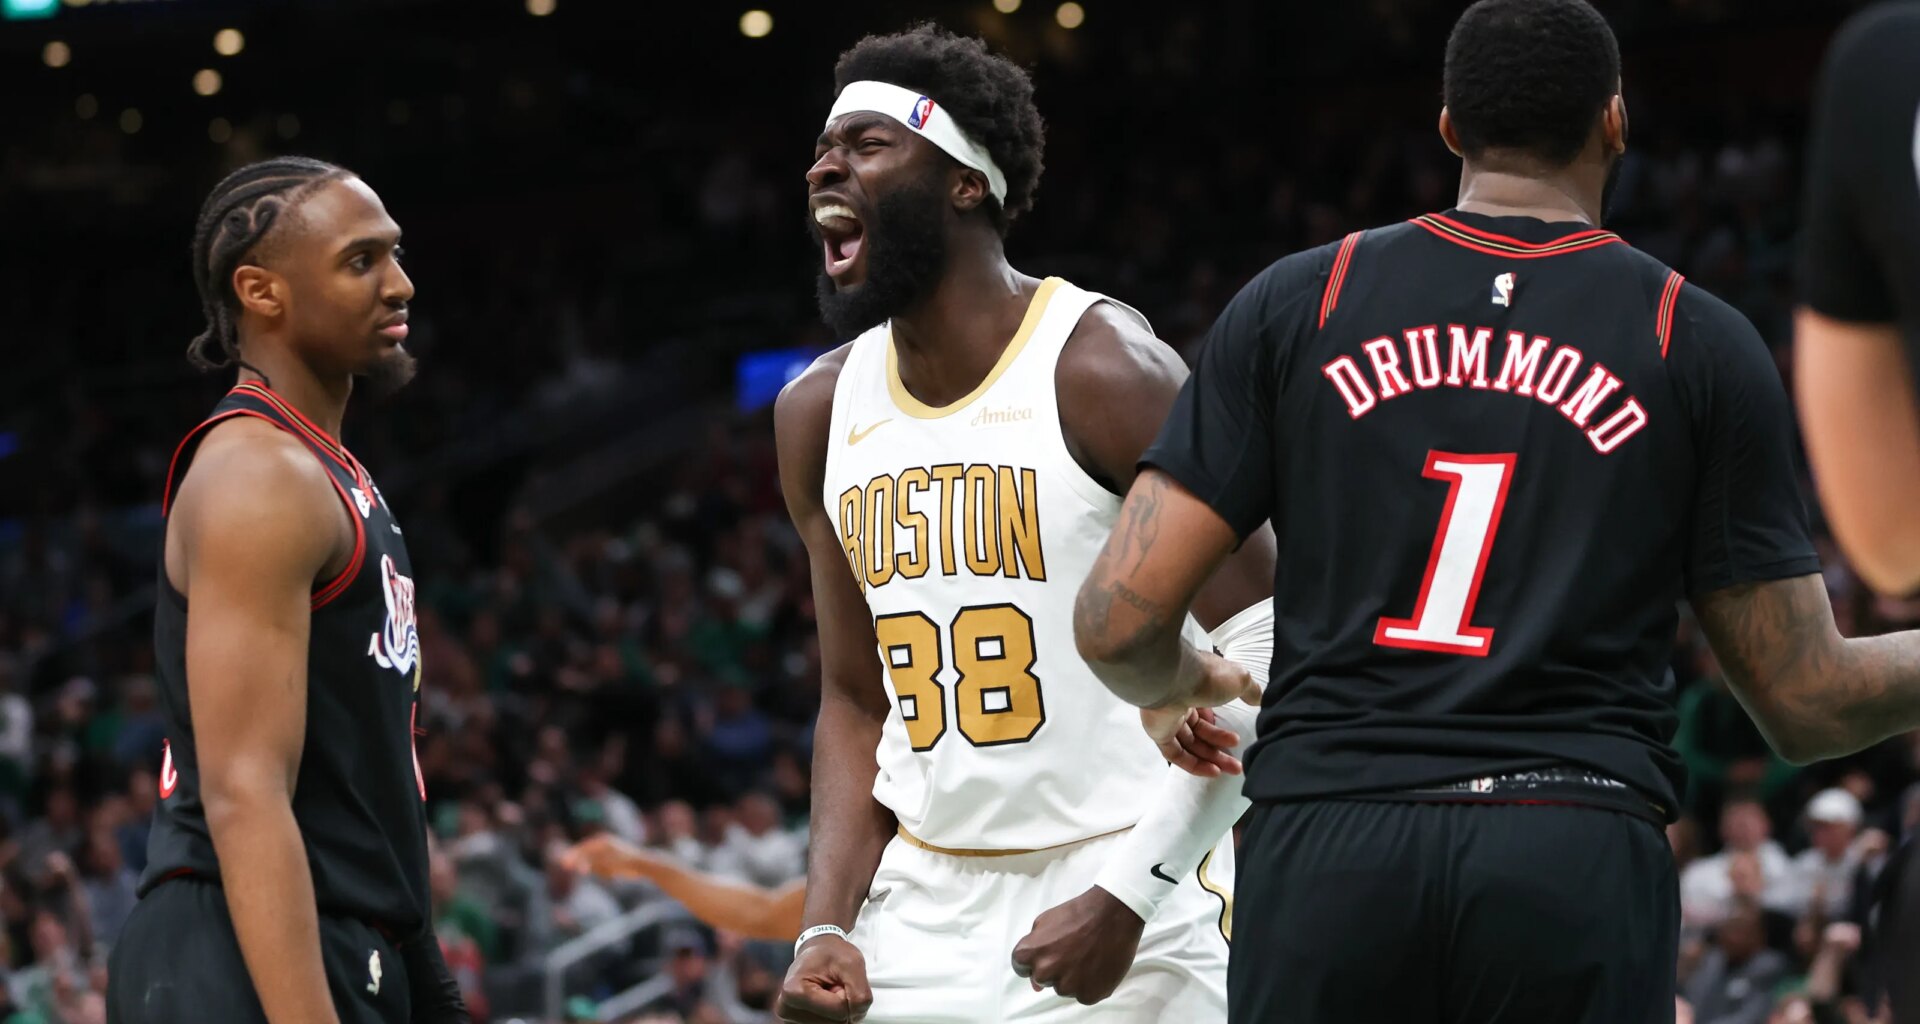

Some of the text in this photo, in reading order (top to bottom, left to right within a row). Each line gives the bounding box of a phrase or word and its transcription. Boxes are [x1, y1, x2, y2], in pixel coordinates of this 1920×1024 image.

[970, 405, 1033, 427] Amica
[1321, 323, 1649, 455] DRUMMOND
[838, 462, 1048, 598] BOSTON
[1372, 448, 1518, 657] 1
[874, 602, 1047, 752] 88
